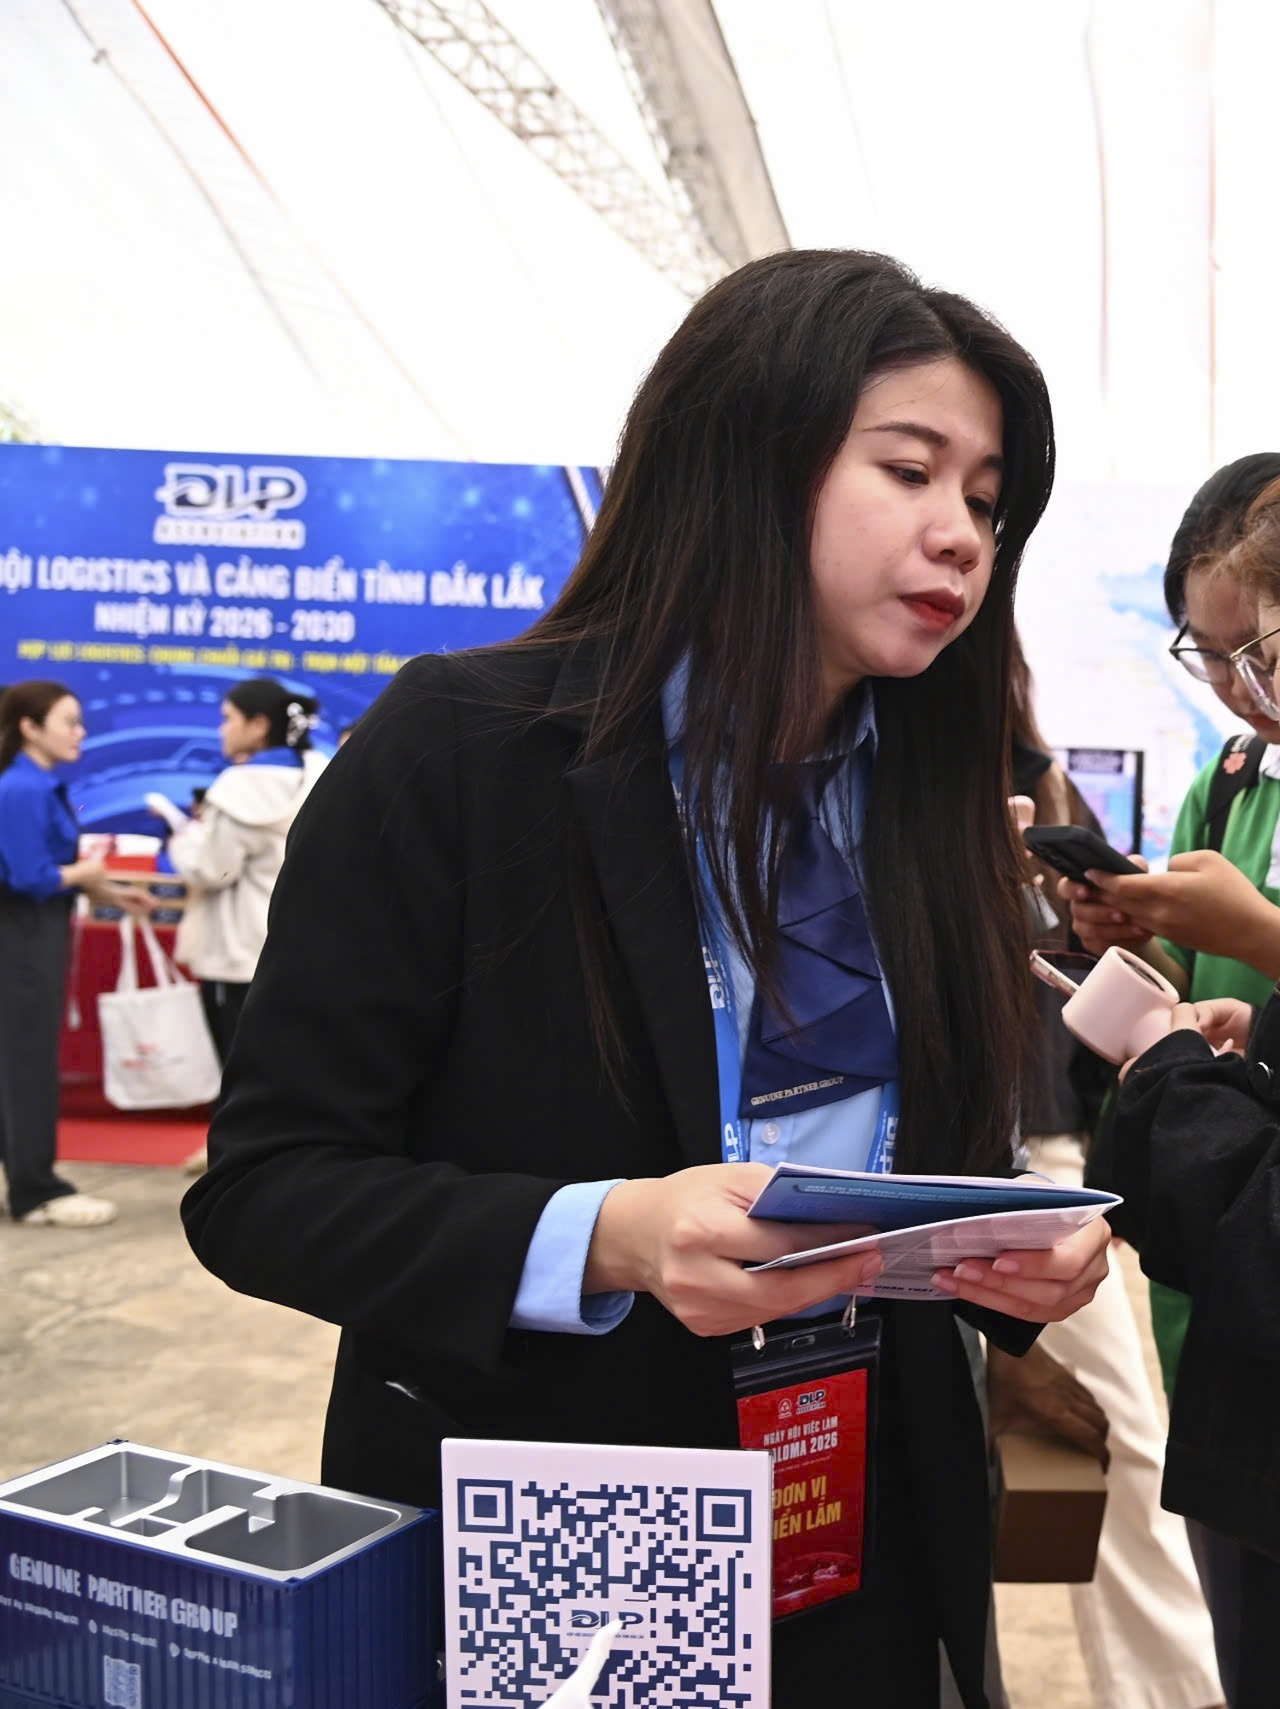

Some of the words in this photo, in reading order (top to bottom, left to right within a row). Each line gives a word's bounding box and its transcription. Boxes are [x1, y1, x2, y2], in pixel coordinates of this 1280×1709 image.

[0, 546, 32, 594] ỘI
[37, 555, 172, 595] LOGISTICS
[174, 552, 212, 596] VÀ
[291, 609, 355, 643] 2030
[784, 1082, 818, 1098] PARTNER
[798, 1390, 826, 1406] DLP
[810, 1431, 838, 1454] 2026
[811, 1475, 826, 1500] VỊ
[774, 1508, 801, 1540] IỂN
[9, 1553, 81, 1597] GENUINE
[88, 1574, 168, 1620] PARTNER
[171, 1598, 238, 1637] GROUP
